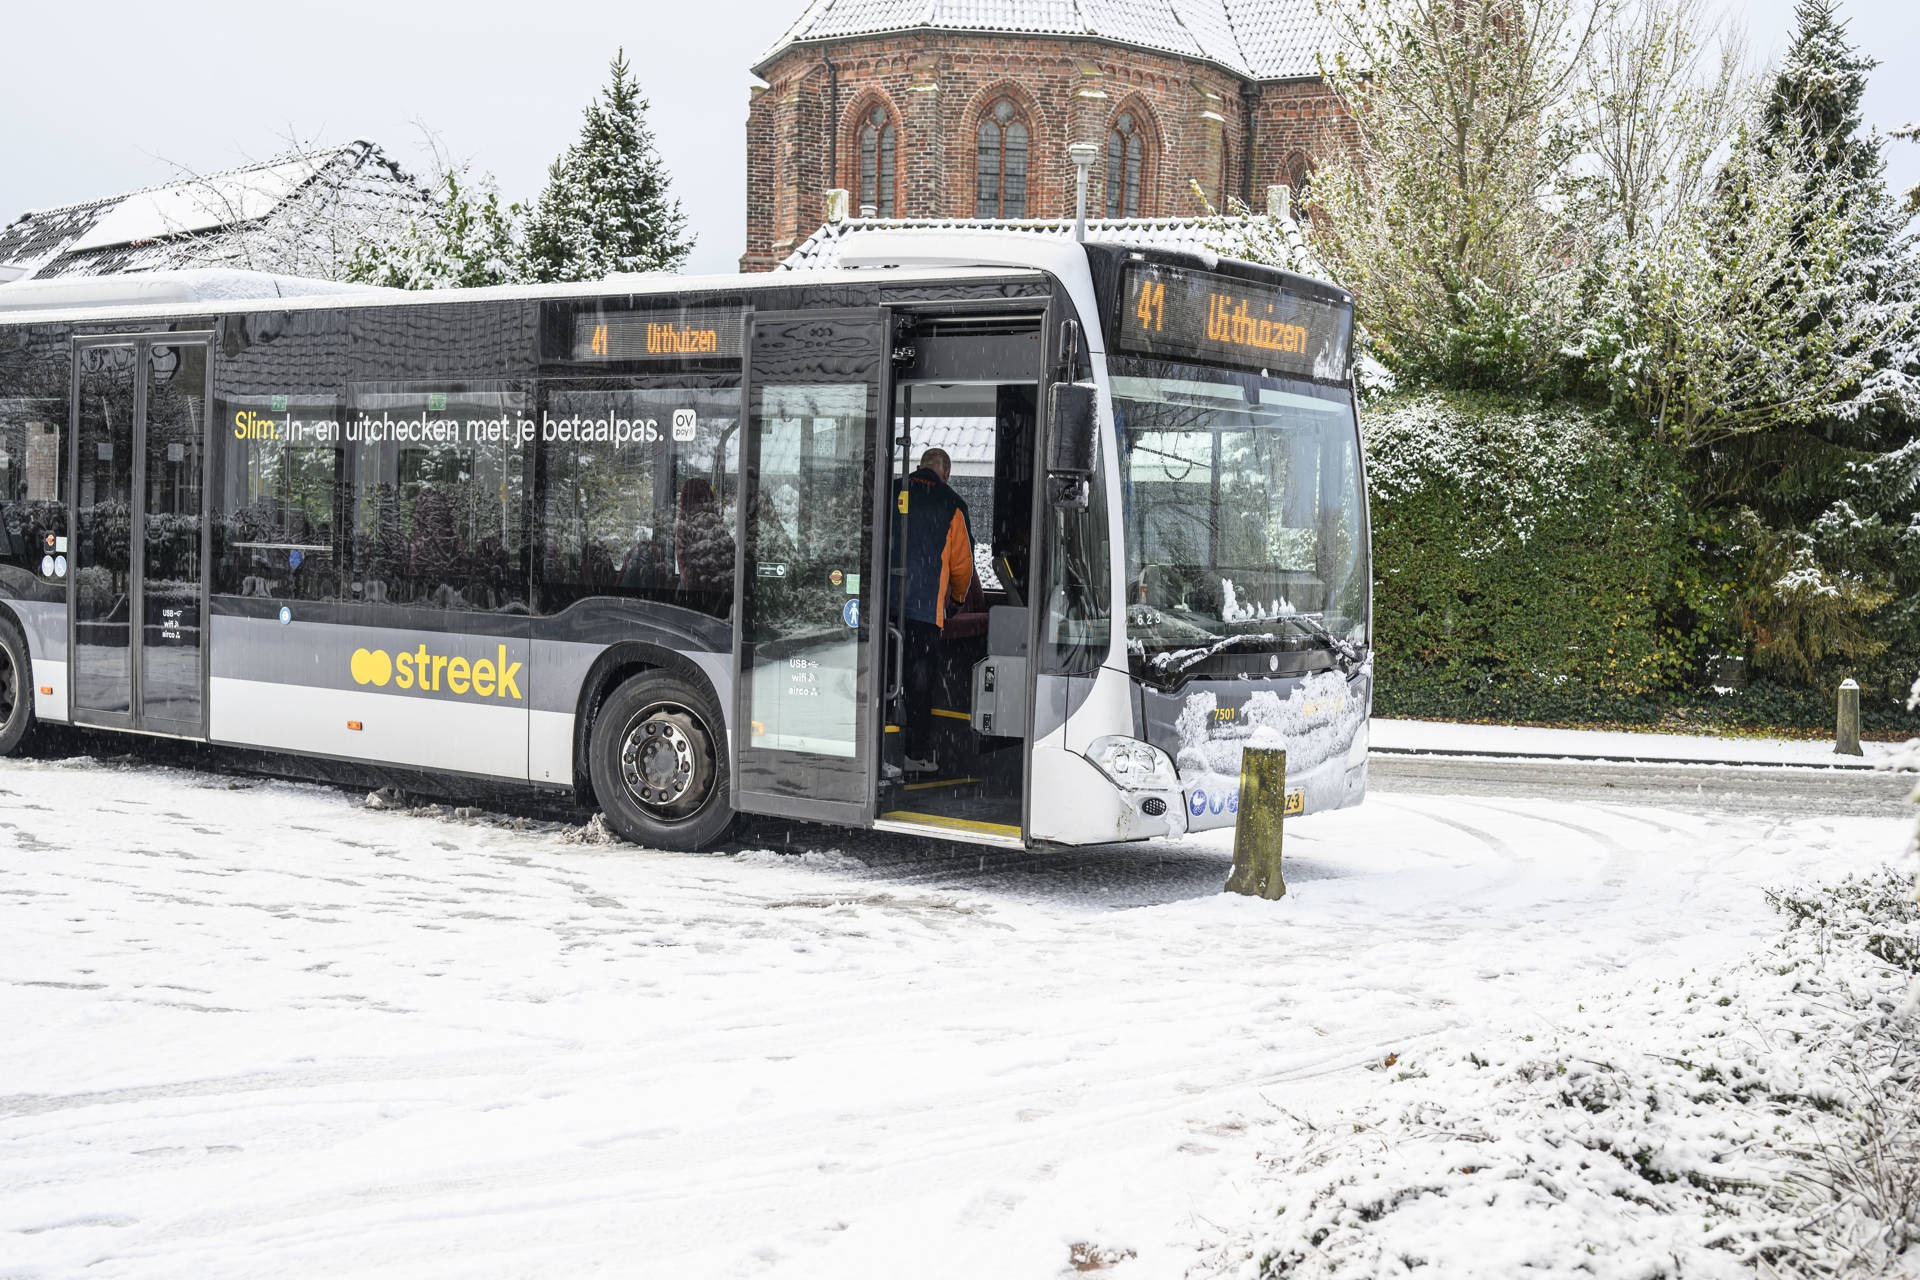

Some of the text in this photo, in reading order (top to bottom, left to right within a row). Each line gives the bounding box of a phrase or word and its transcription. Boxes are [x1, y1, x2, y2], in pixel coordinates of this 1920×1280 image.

[1137, 281, 1165, 331] 41
[1208, 293, 1306, 354] Uithuizen
[591, 323, 717, 355] 41 Uithuizen
[234, 410, 664, 449] Slim. In- en uitchecken met je betaalpas.
[676, 414, 694, 427] OV
[162, 609, 174, 617] USB
[395, 644, 523, 699] streek
[789, 659, 807, 668] USB
[791, 671, 807, 682] wifi
[1214, 707, 1235, 720] 7501
